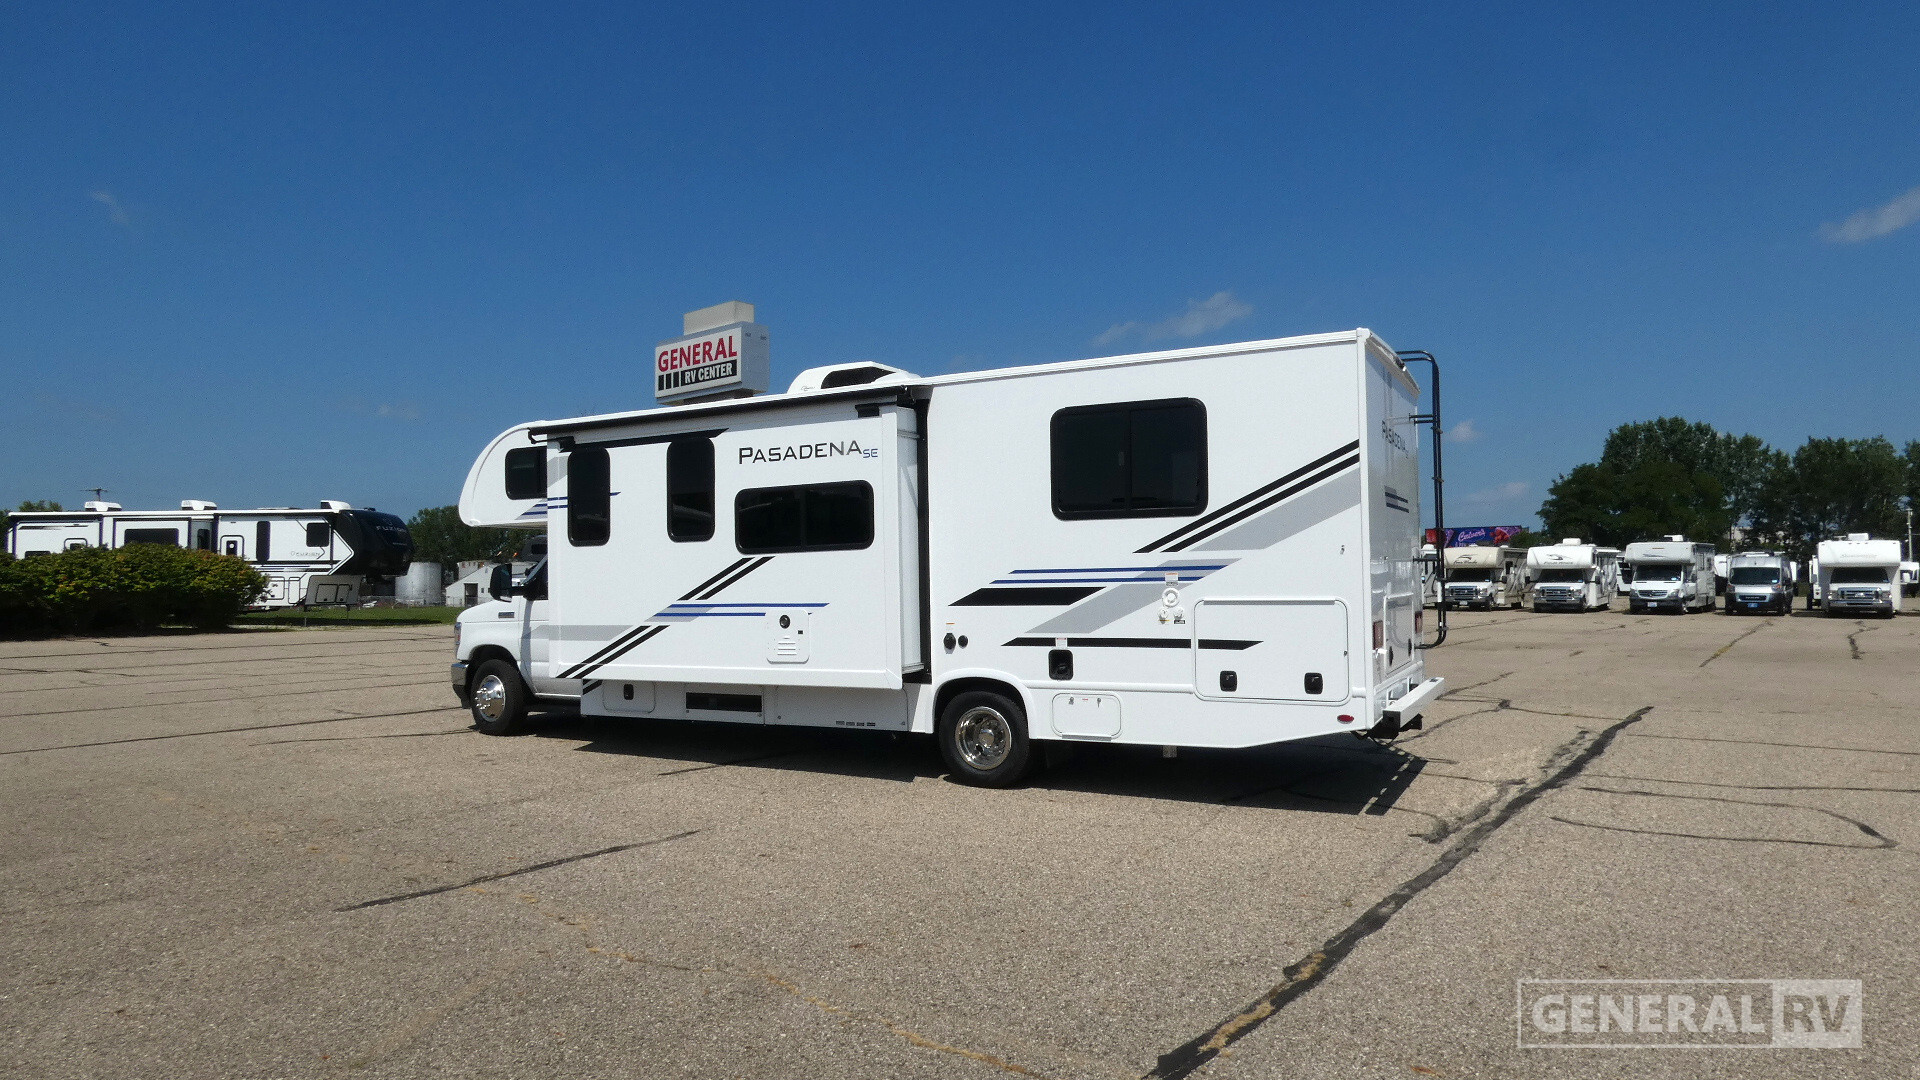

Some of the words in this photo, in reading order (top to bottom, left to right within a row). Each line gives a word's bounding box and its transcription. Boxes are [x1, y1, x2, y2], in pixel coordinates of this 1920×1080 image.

[658, 335, 738, 372] GENERAL
[684, 370, 697, 384] RV
[697, 362, 733, 381] CENTER
[738, 440, 862, 465] PASADENA
[862, 448, 879, 459] SE
